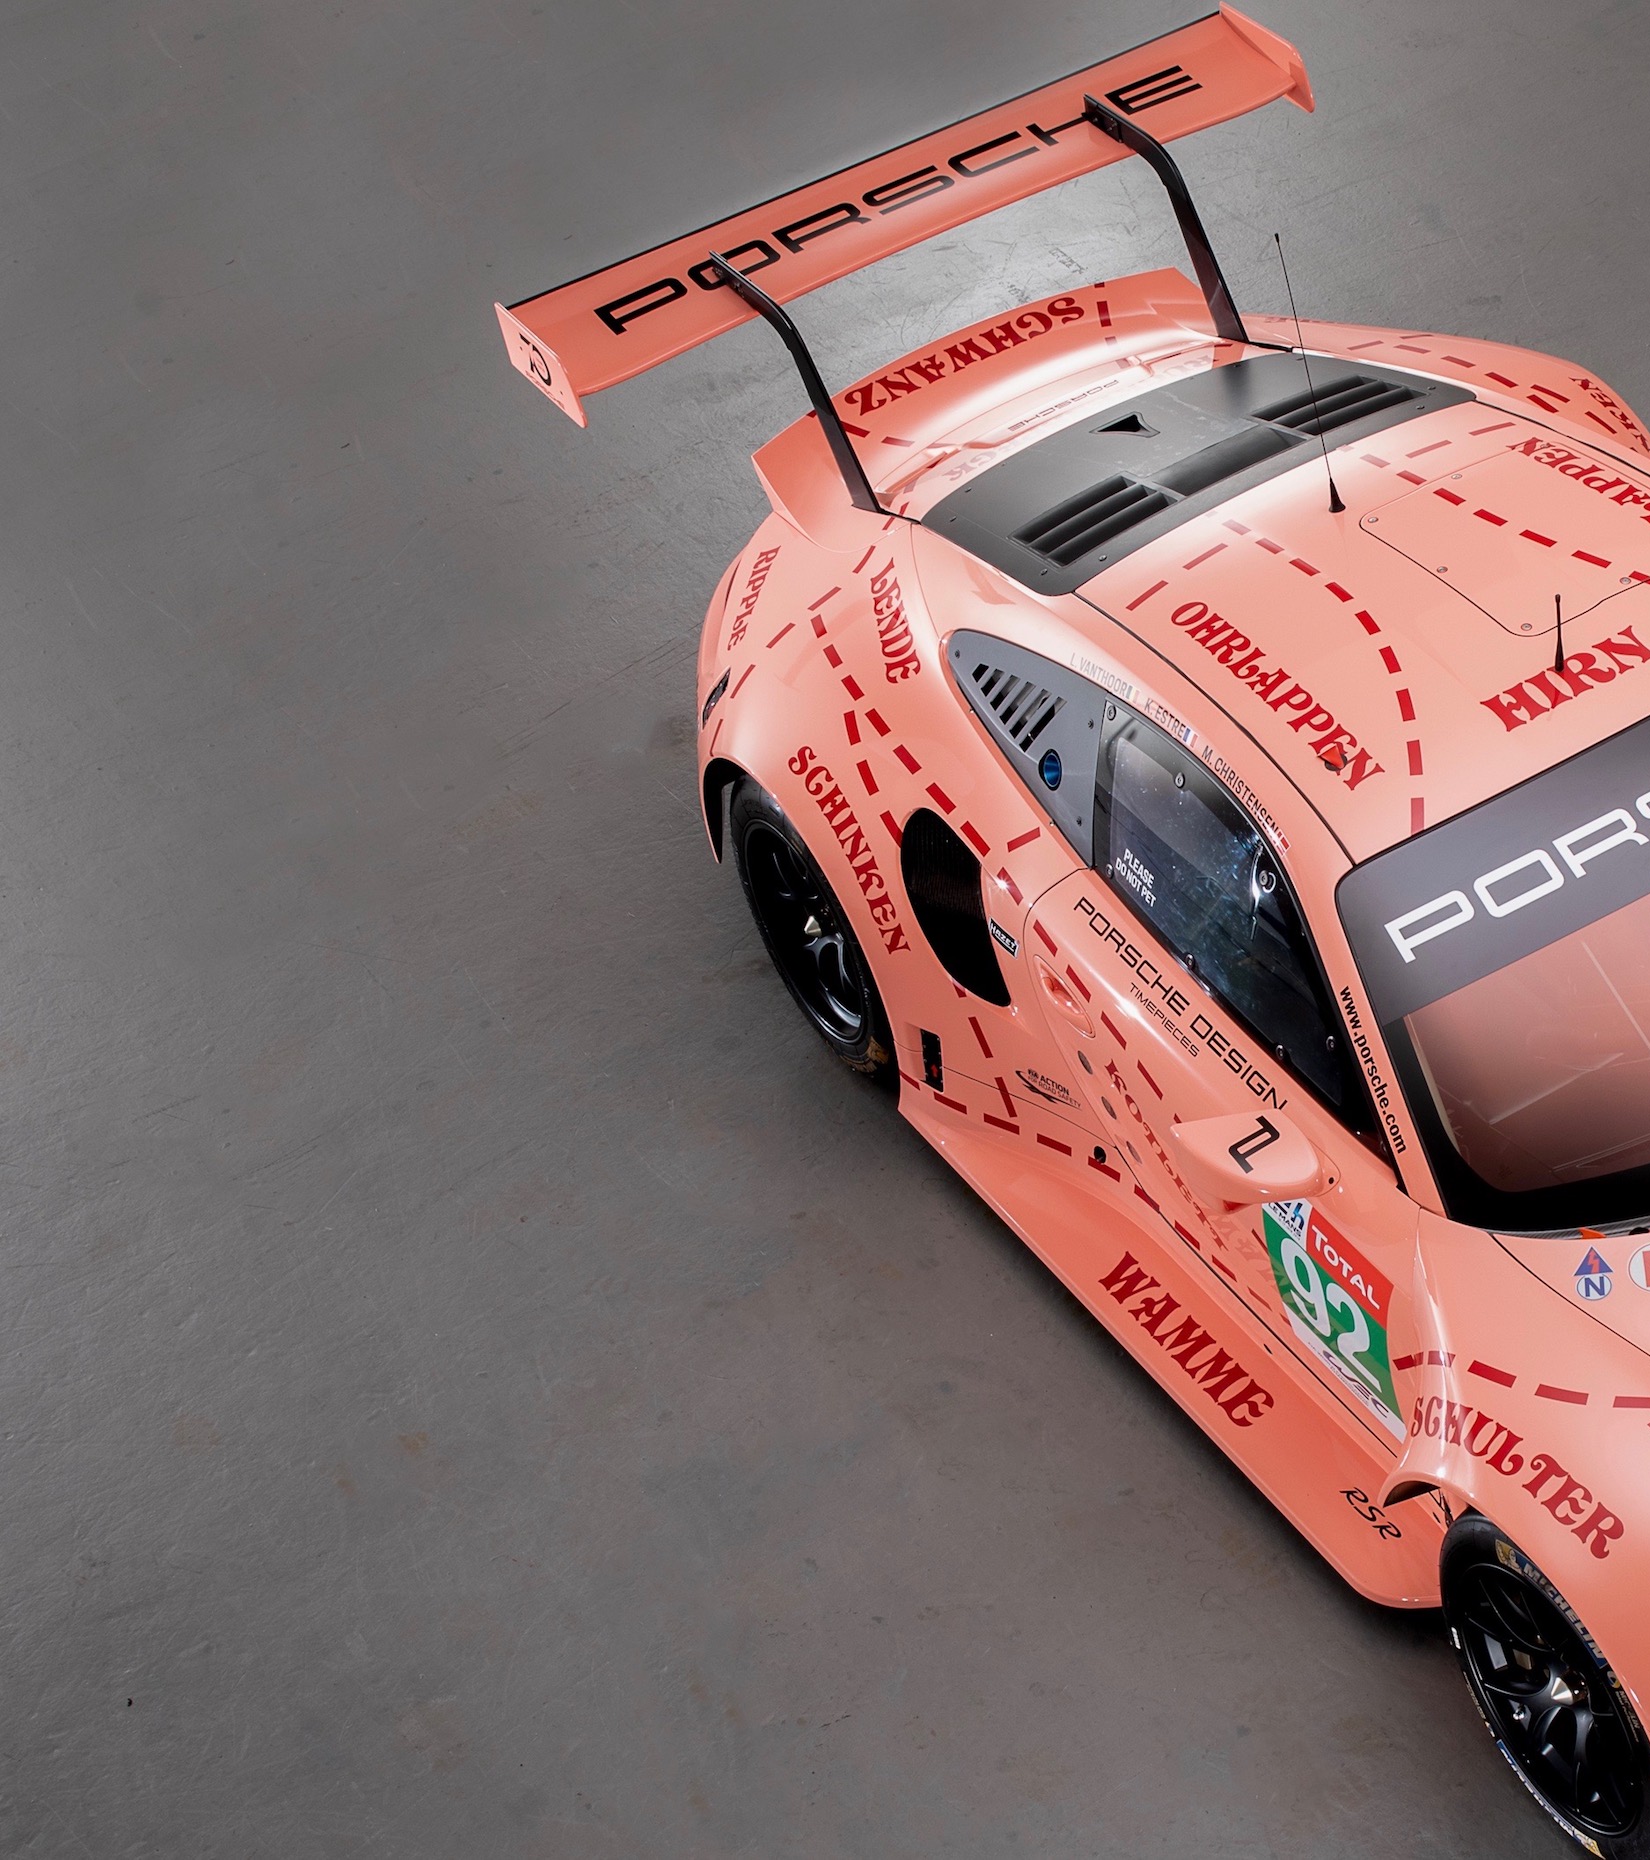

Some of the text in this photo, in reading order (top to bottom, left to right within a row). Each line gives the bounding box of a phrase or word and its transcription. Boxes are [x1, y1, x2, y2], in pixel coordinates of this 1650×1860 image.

[593, 65, 1203, 336] PORSCHE
[844, 297, 1085, 416] SCHWANZ
[1007, 379, 1120, 432] PORSCHE
[727, 544, 781, 652] RIPPLE
[870, 557, 920, 684] LENDE
[1144, 698, 1186, 739] K. ESTRE
[1170, 600, 1386, 792] OHRLAPPEN
[1201, 745, 1281, 842] M. CHRISTENSEN
[787, 745, 912, 955] SCHINKEN
[1115, 857, 1157, 908] DO NOT PET
[1123, 848, 1155, 889] PLEASE
[989, 921, 1017, 949] HAZET
[1073, 896, 1288, 1110] PORSCHE DESIGN
[1130, 982, 1200, 1058] TIMEPIECES
[1040, 1073, 1070, 1096] ACTION
[1338, 985, 1408, 1155] www.porsche.com
[1278, 1212, 1303, 1239] MANS
[1311, 1225, 1380, 1310] TOTAL
[1281, 1237, 1383, 1394] 92
[1584, 1276, 1606, 1298] N
[1098, 1251, 1275, 1428] WAMME
[1339, 1486, 1402, 1540] RSR
[1410, 1396, 1626, 1559] SCHULTER
